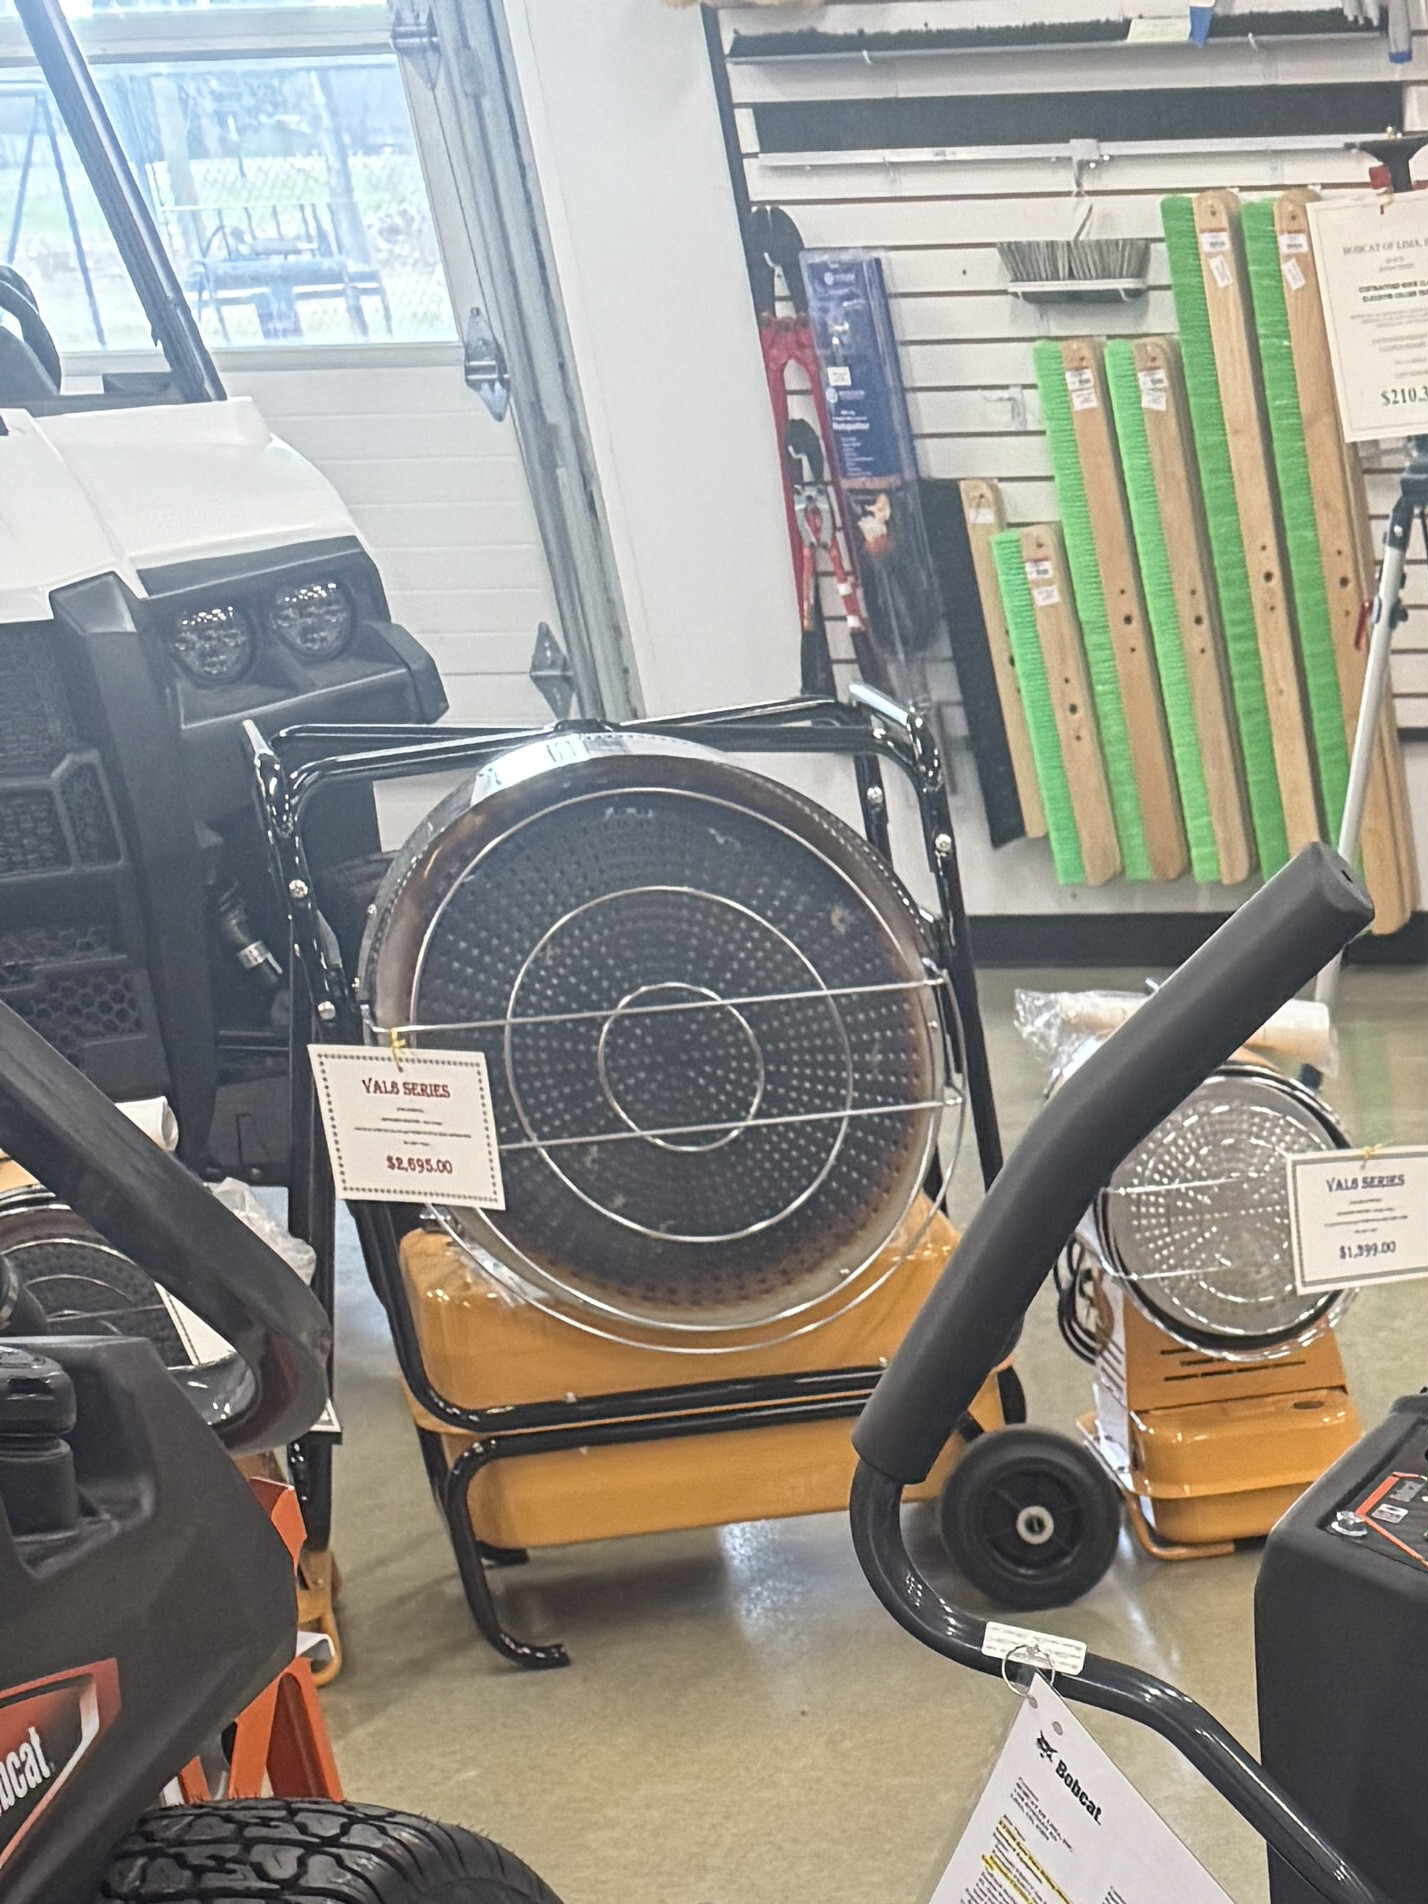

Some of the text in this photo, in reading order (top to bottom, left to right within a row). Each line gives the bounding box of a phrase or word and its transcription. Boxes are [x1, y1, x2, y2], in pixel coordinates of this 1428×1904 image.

[403, 1081, 451, 1098] SERIES
[386, 1155, 453, 1174] $2,695.00
[1361, 1174, 1405, 1189] SERIES
